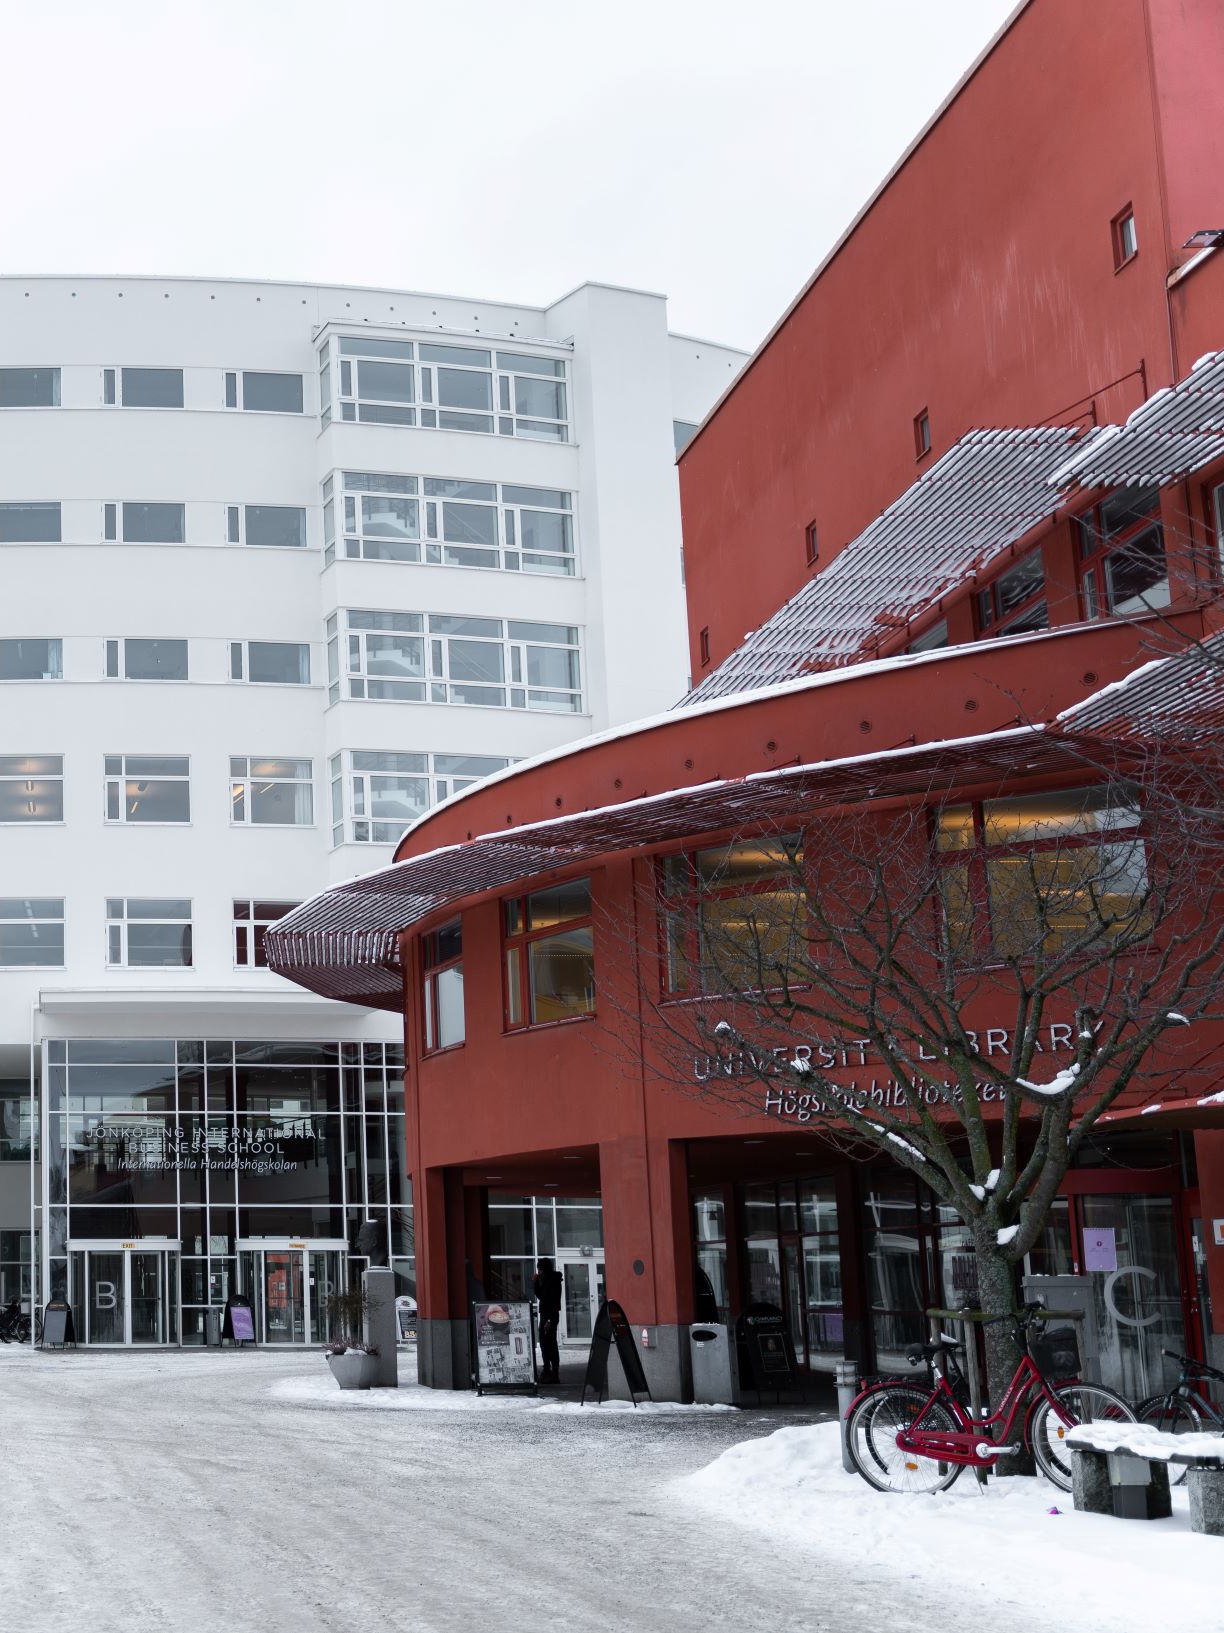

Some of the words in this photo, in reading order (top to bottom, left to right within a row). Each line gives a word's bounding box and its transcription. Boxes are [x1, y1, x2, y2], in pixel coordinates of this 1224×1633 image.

[694, 1035, 896, 1081] UNIVERSIT
[86, 1125, 185, 1139] JÖNKÖPING
[193, 1127, 326, 1139] INTERNATIONAL
[128, 1142, 210, 1153] BUSINESS
[217, 1142, 285, 1153] SCHOOL
[117, 1157, 197, 1170] Internationella
[200, 1157, 297, 1173] Handelshögskolan
[96, 1281, 117, 1309] B
[1104, 1265, 1161, 1327] C
